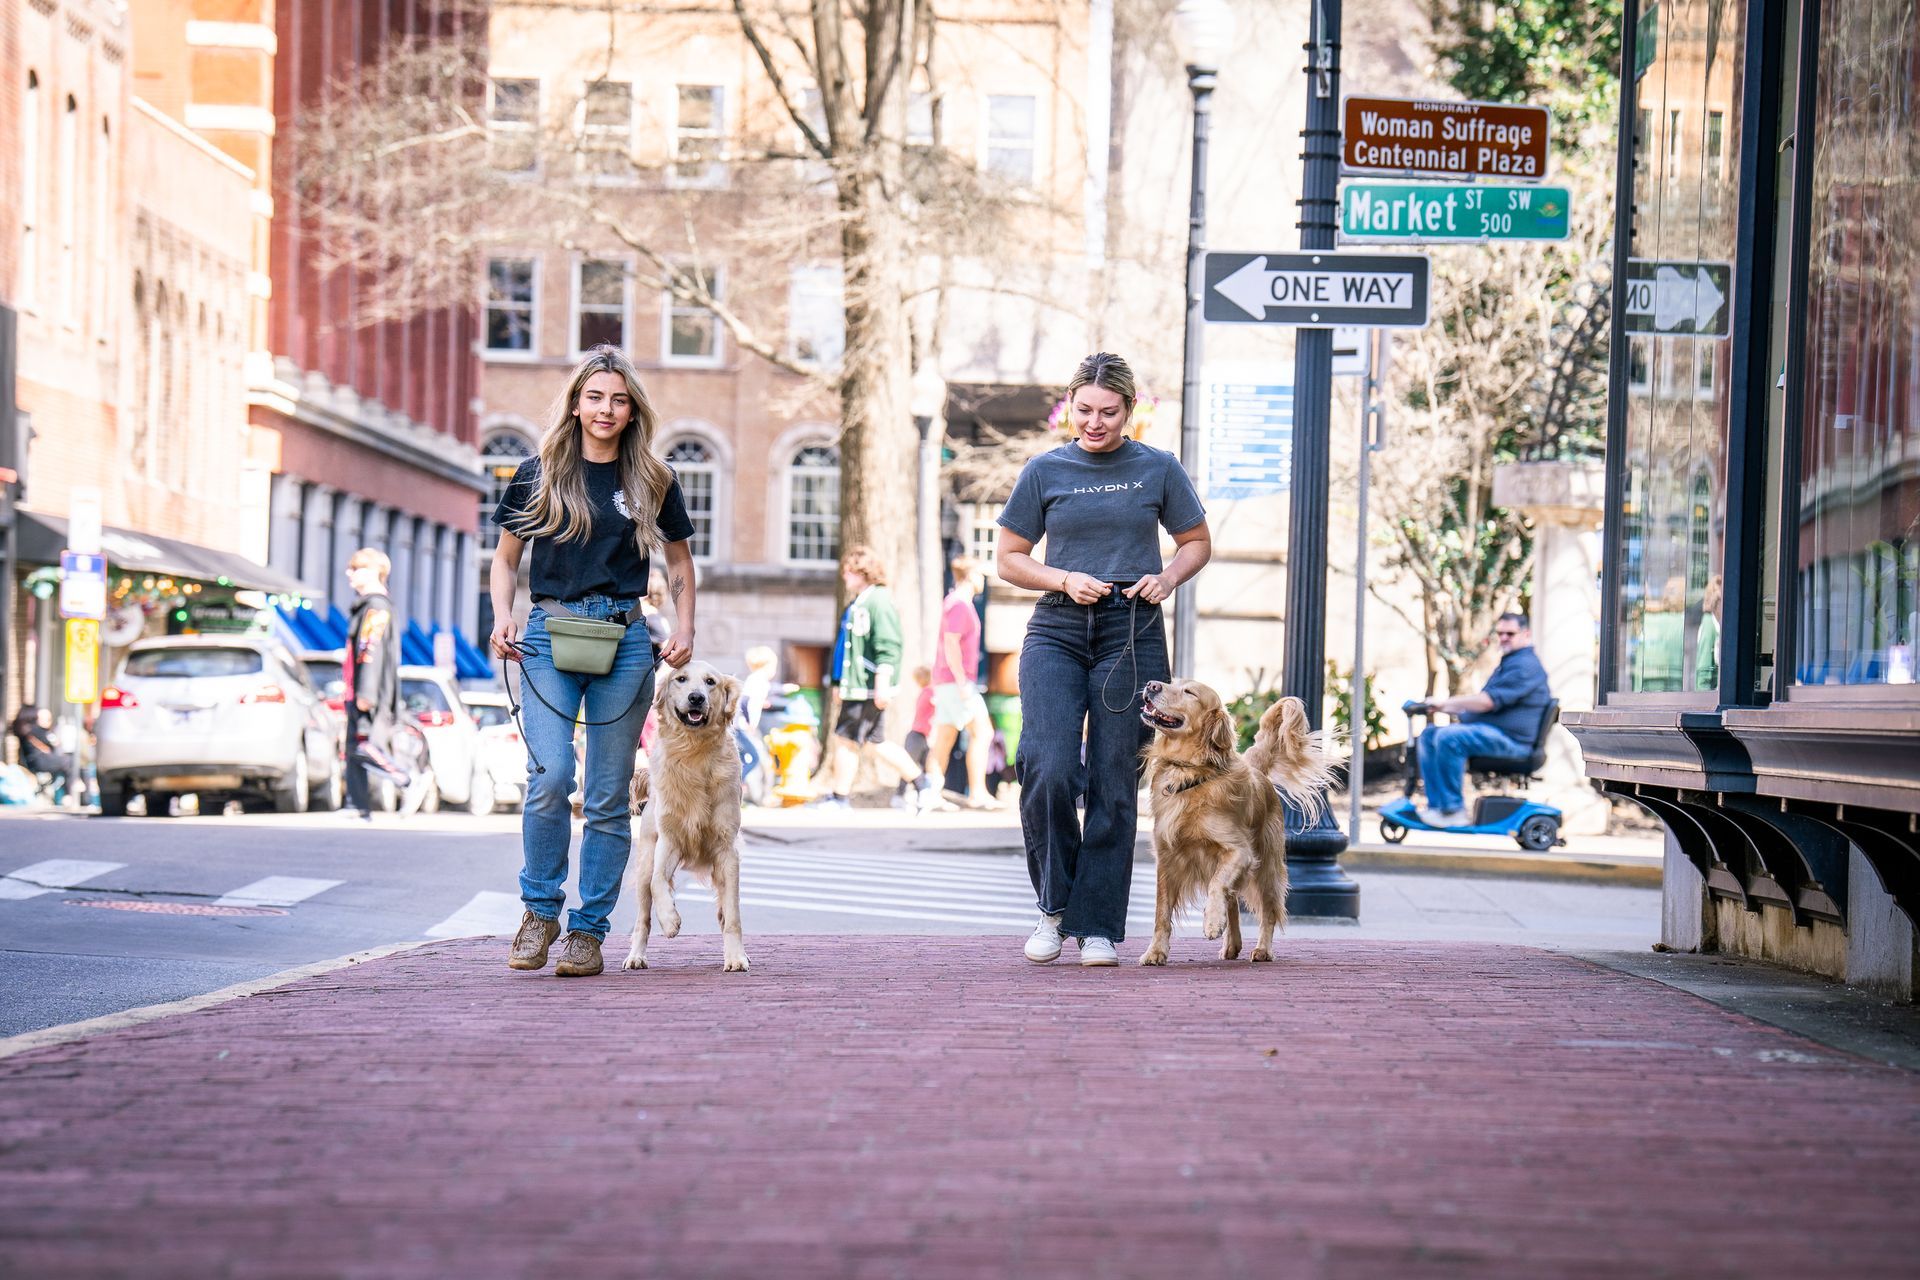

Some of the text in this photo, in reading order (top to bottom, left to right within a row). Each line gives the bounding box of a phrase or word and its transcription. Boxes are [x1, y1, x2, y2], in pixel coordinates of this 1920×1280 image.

[1360, 111, 1533, 151] Woman Suffrage
[1354, 140, 1537, 174] Centennial Plaza
[1349, 189, 1532, 232] Market ST SW
[1480, 213, 1512, 233] 500
[1271, 275, 1404, 303] ONE WAY
[1074, 480, 1143, 493] HAYDN X
